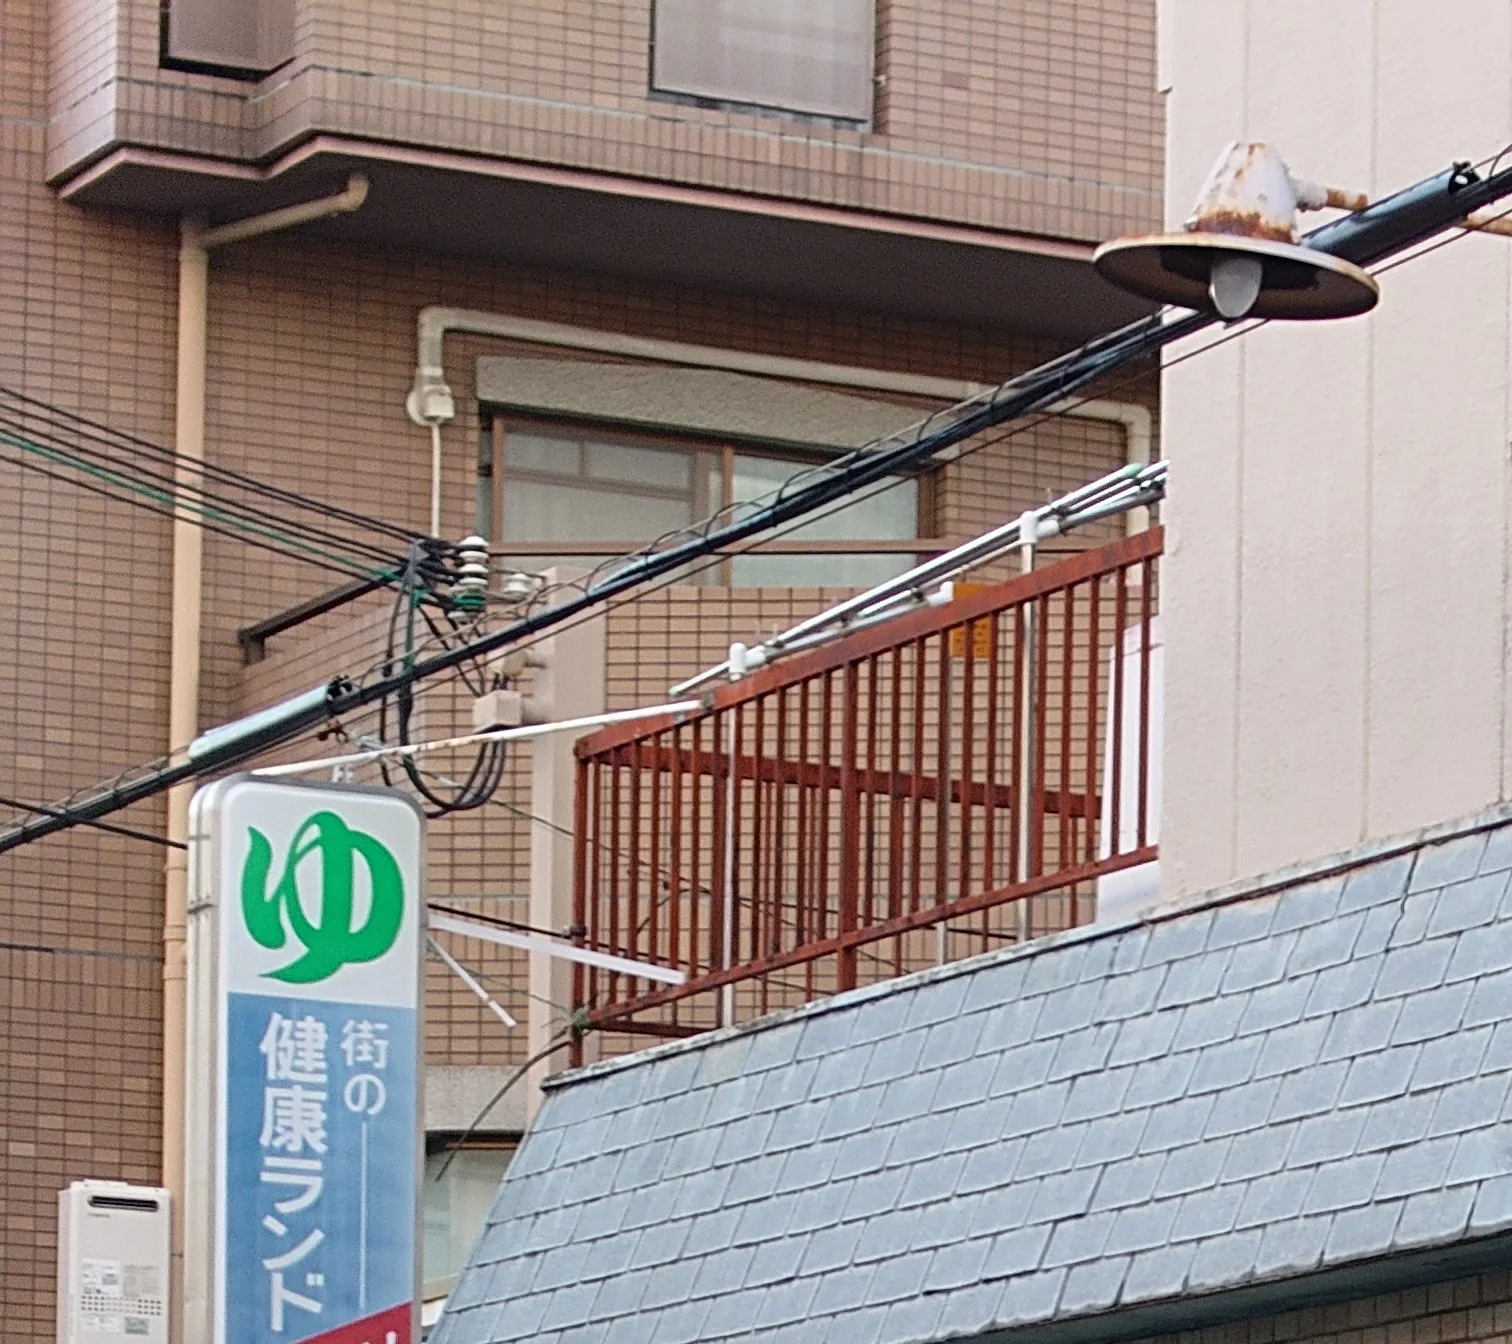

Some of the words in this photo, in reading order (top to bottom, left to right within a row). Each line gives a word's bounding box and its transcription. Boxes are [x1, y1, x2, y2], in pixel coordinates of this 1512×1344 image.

[241, 811, 404, 984] ゆ
[340, 1018, 390, 1116] 街の
[258, 1011, 329, 1332] 健康ランド
